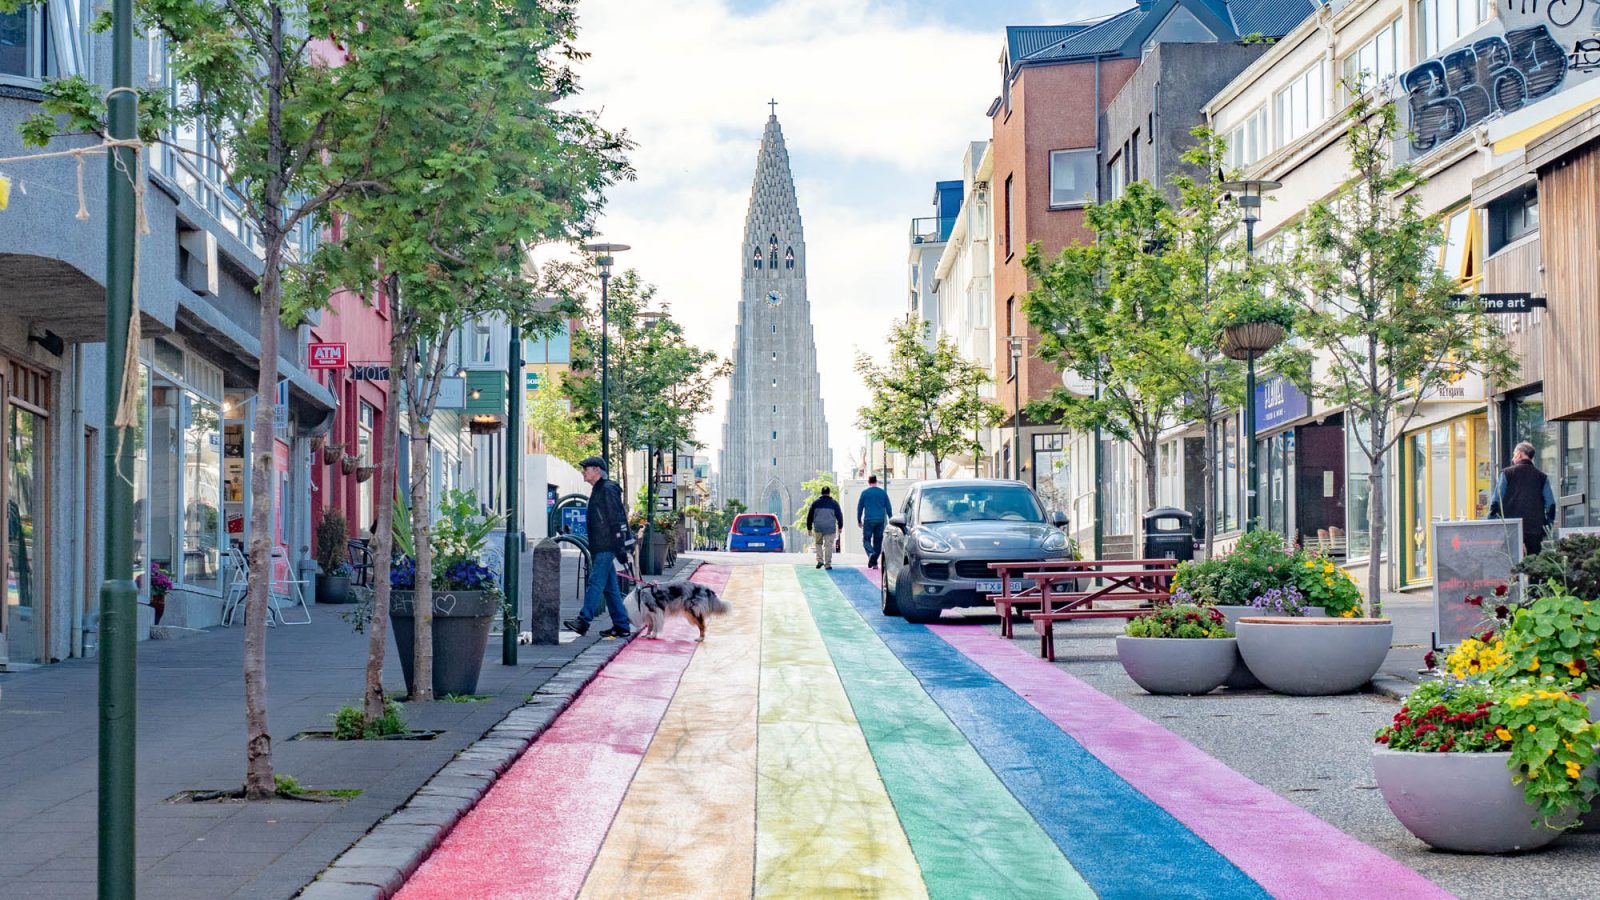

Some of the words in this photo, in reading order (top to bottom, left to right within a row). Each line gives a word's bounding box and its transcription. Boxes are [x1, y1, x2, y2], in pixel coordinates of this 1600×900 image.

[1507, 298, 1526, 308] art
[314, 347, 341, 359] ATM
[354, 367, 390, 381] MOK
